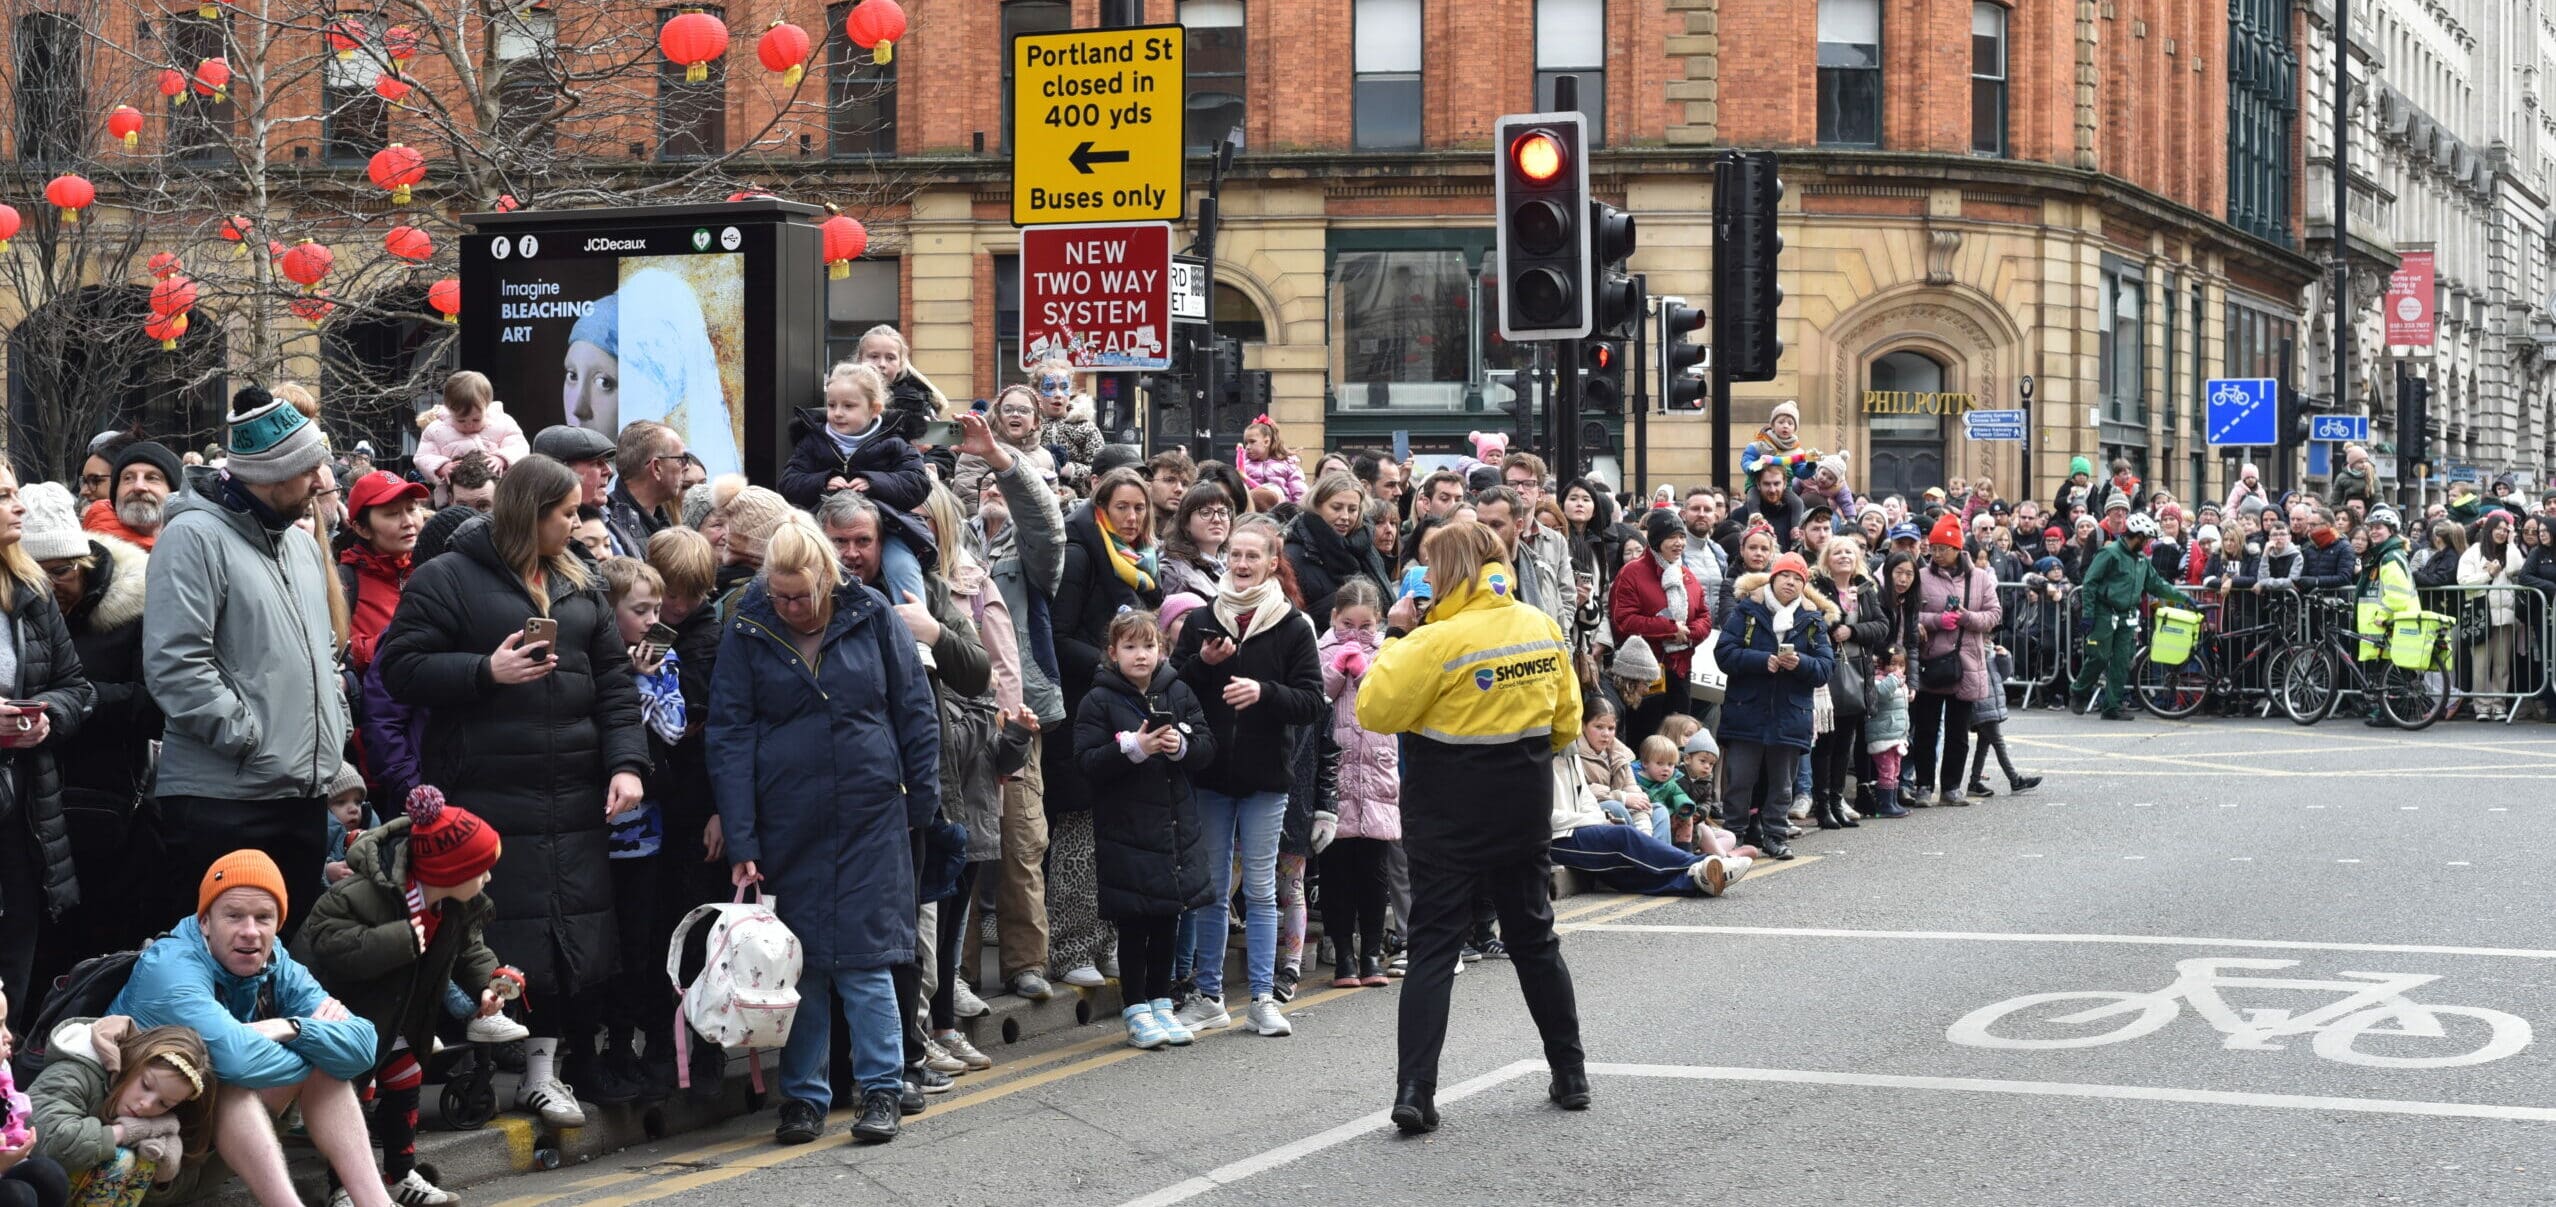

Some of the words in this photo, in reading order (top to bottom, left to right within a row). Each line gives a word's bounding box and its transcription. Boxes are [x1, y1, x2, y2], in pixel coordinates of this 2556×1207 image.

[1027, 39, 1133, 67] Portland
[1144, 38, 1173, 61] St
[1043, 71, 1122, 97] closed
[1133, 70, 1154, 92] in
[1045, 104, 1100, 127] 400
[1110, 102, 1152, 129] yds
[1031, 188, 1103, 210] Buses
[1113, 183, 1166, 210] only
[584, 238, 646, 252] JCDecaux
[1066, 240, 1126, 265] NEW
[501, 278, 560, 300] Imagine
[1034, 271, 1091, 295] TWO
[1100, 270, 1157, 293] WAY
[501, 301, 595, 319] BLEACHING
[1043, 300, 1147, 325] SYSTEM
[501, 326, 532, 343] ART
[1049, 331, 1141, 353] AEAD
[1862, 390, 1977, 416] PHILPOTTS
[1496, 657, 1557, 682] SHOWSEC
[434, 815, 477, 851] MAN
